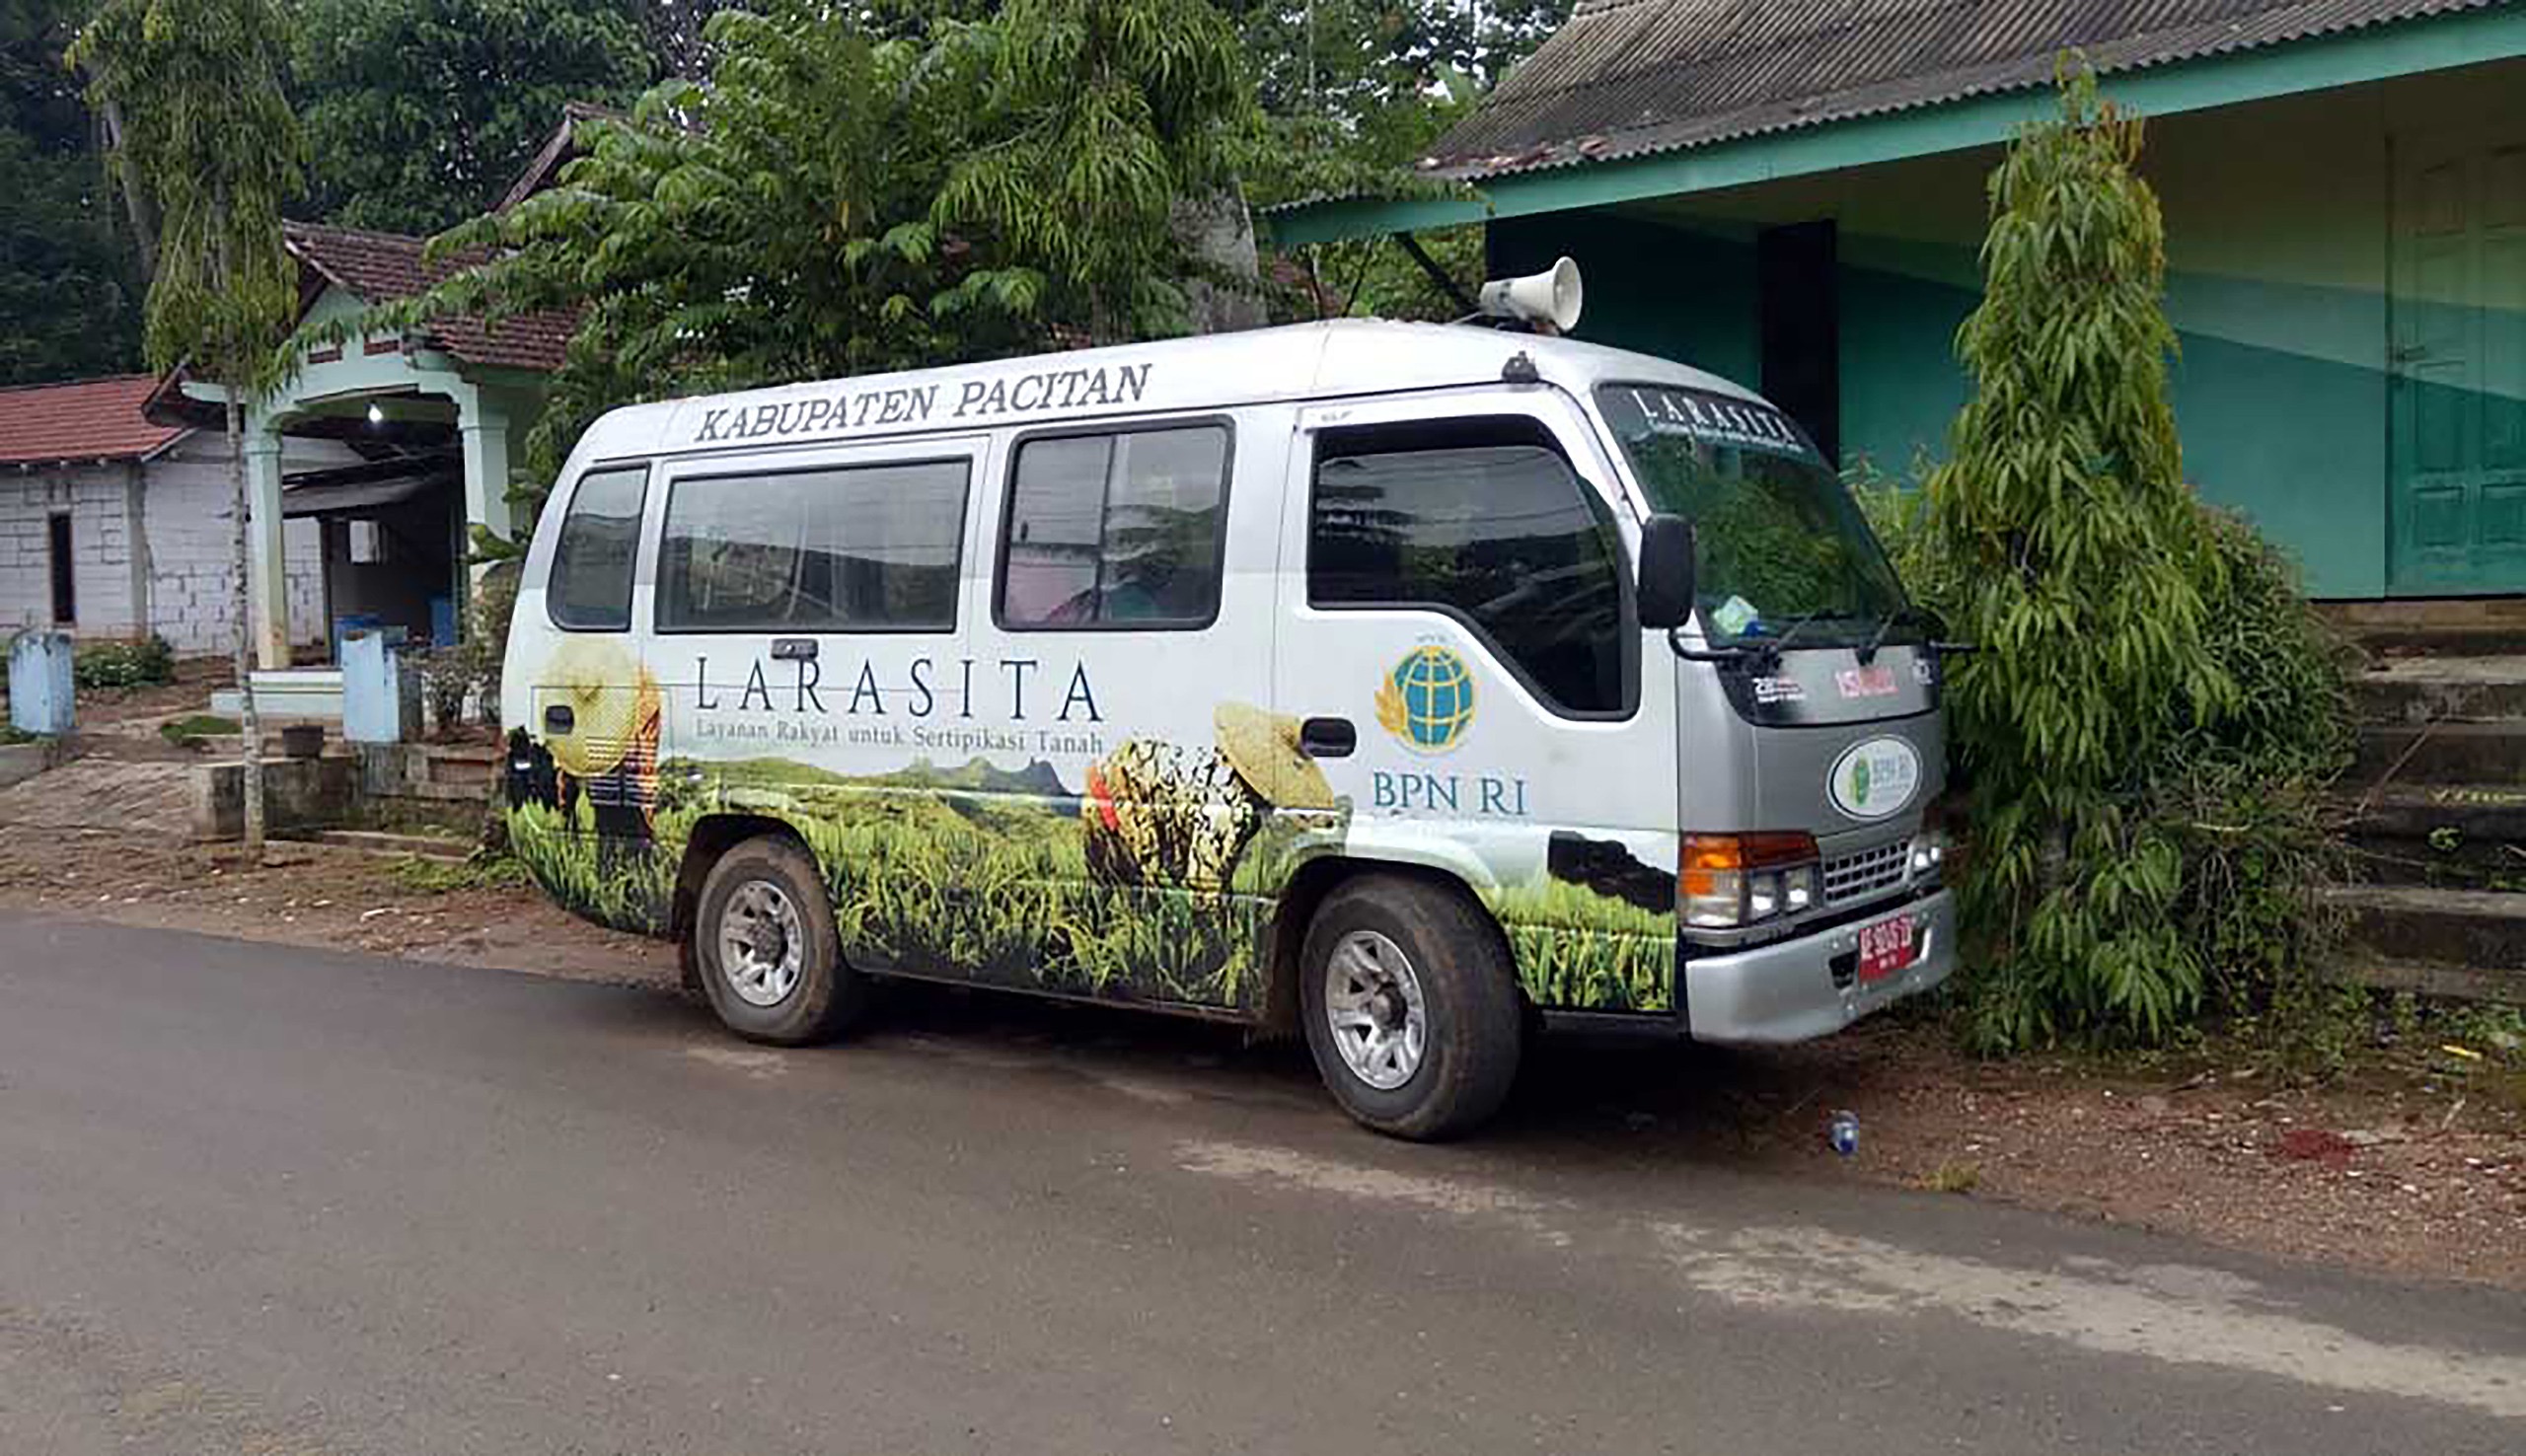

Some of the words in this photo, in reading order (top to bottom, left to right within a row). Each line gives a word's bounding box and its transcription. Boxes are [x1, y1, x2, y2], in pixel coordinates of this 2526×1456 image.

[694, 385, 940, 442] KABUPATEN
[952, 362, 1153, 418] PACITAN
[1631, 389, 1797, 443] LARASITA
[696, 656, 1104, 723] LARASITA
[696, 718, 769, 742] Layanan
[778, 720, 838, 748] Rakyat
[848, 725, 905, 746] untuk
[912, 725, 1026, 754] Sertipikasi
[1038, 730, 1103, 755] Tanah
[1373, 770, 1458, 812] BPN
[1481, 777, 1529, 817] RI
